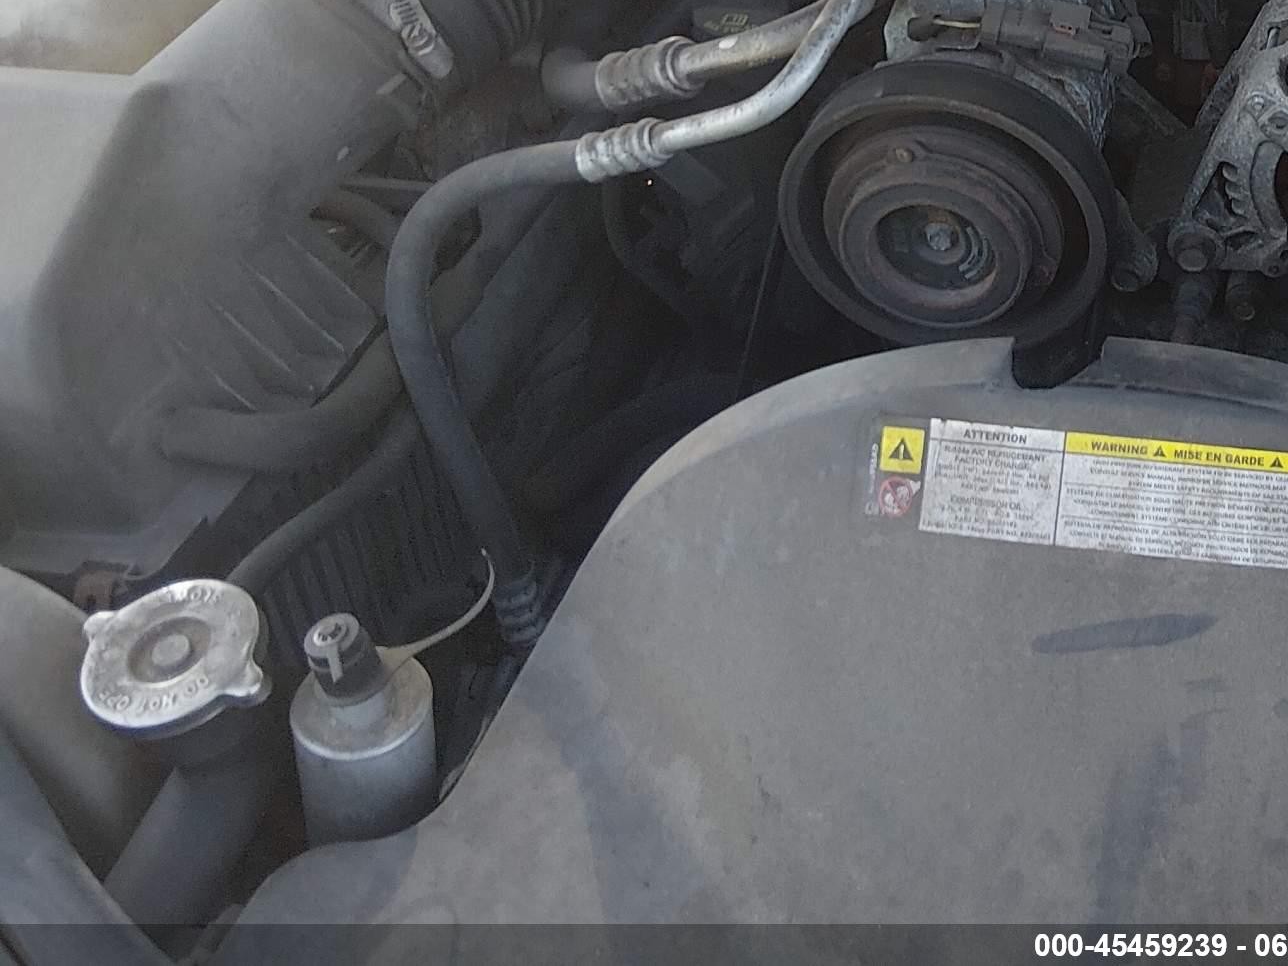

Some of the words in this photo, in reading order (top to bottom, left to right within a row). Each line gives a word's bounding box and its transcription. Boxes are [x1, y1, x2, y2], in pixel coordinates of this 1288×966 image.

[963, 429, 1027, 444] ATTENTION
[1091, 440, 1148, 455] WARNING
[1174, 449, 1202, 461] MISE
[1205, 452, 1222, 462] EN
[1225, 453, 1265, 467] GARDE
